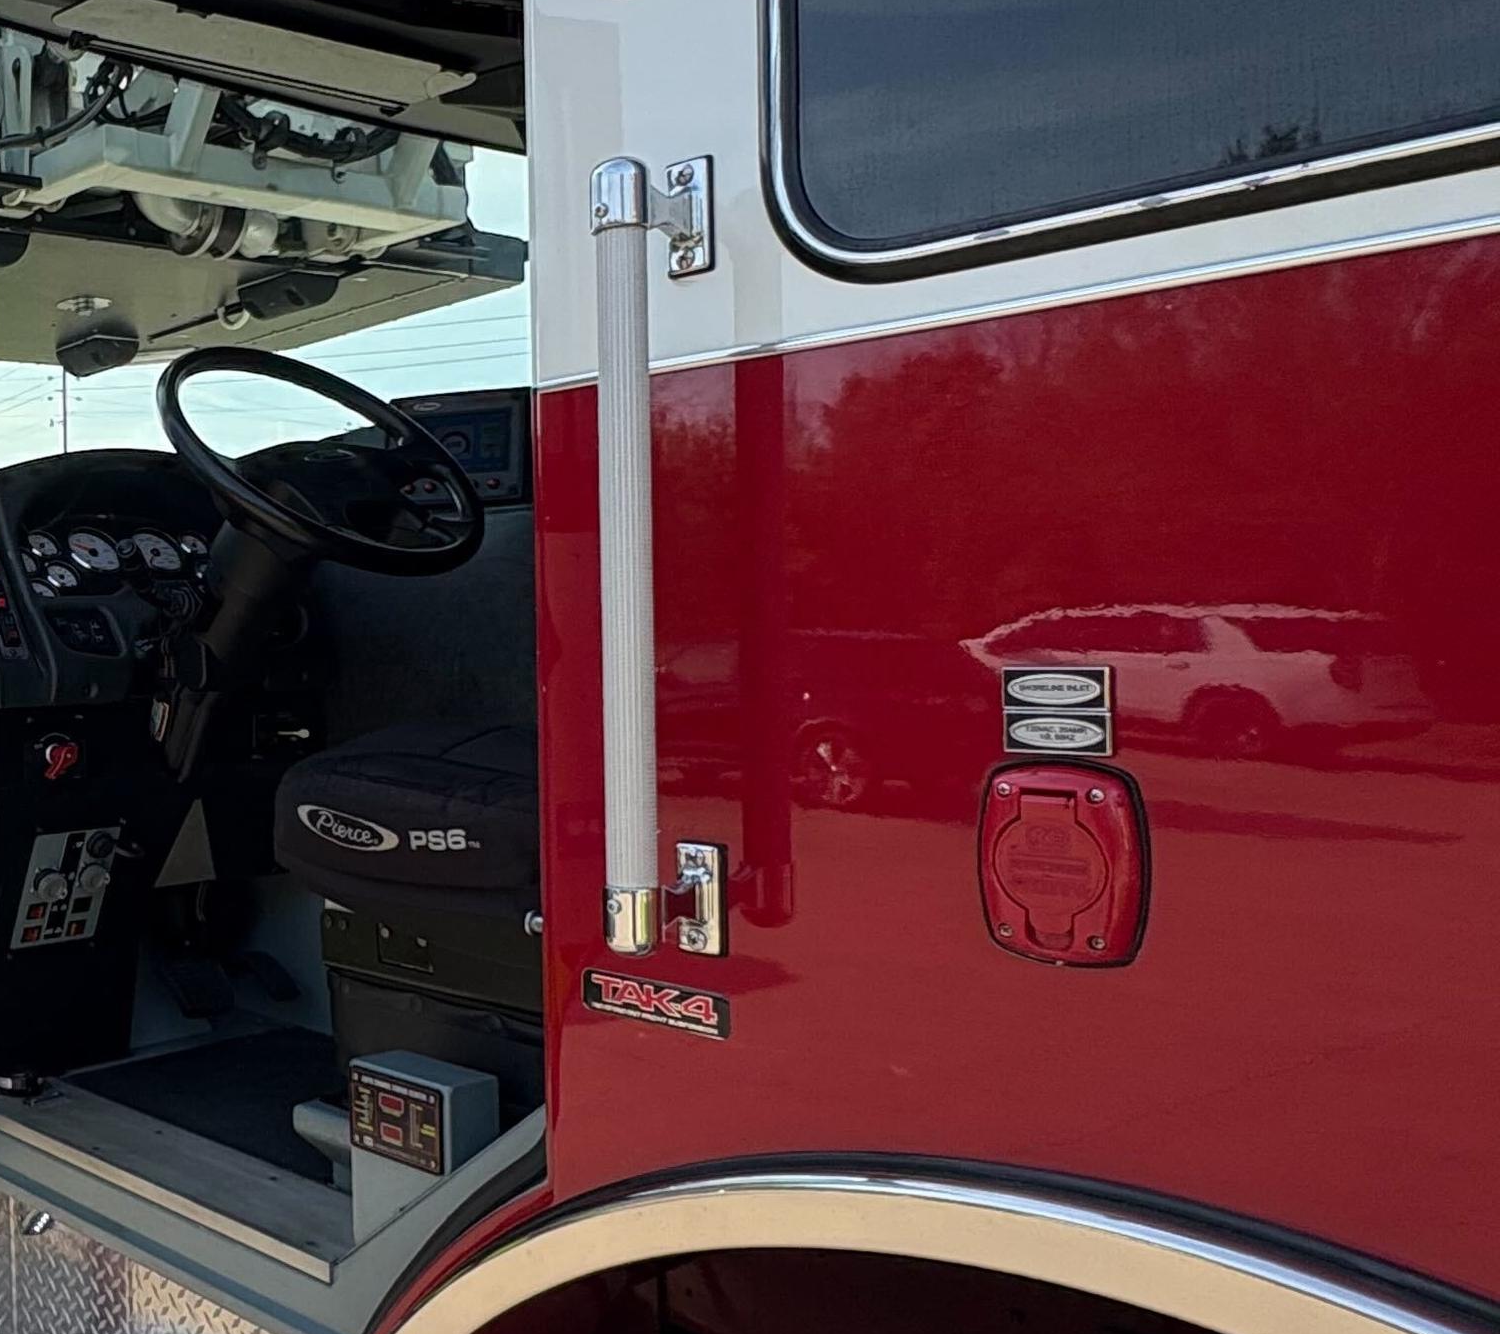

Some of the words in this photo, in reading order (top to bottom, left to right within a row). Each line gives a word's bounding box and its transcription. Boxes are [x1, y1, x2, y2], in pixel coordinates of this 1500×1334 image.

[315, 810, 374, 844] Pierce
[408, 828, 467, 851] PS6
[591, 973, 718, 1025] TAK-4
